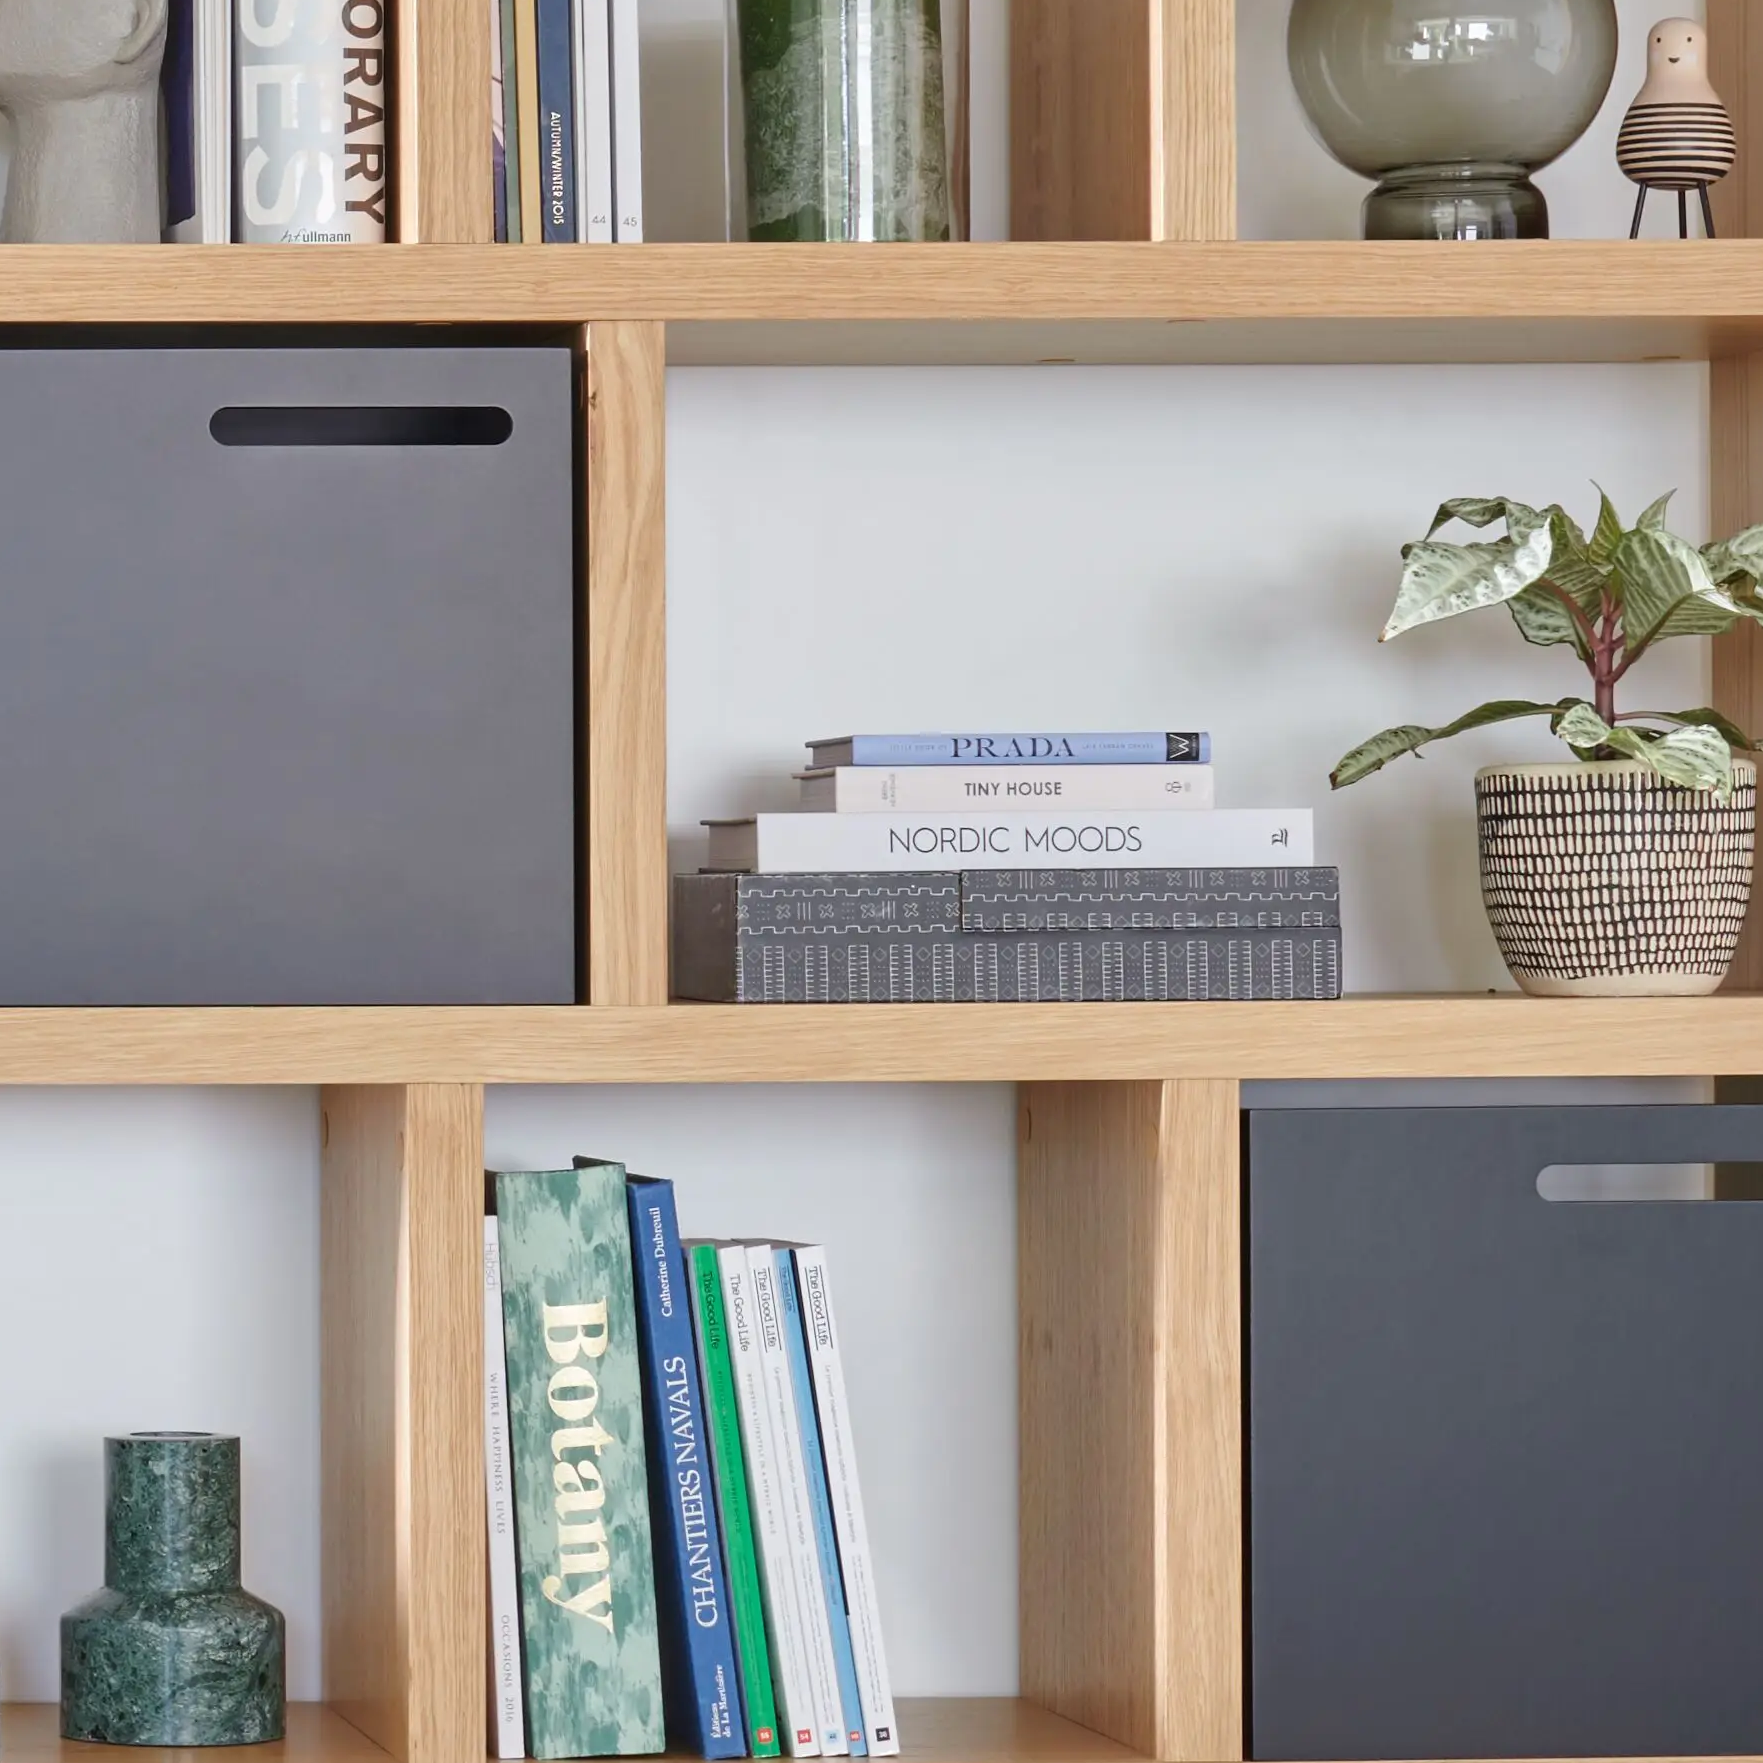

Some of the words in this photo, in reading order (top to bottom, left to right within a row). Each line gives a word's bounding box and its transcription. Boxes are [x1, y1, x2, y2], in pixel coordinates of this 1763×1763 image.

[550, 111, 564, 198] AUTUMN/WINTER
[552, 200, 565, 225] 2015
[950, 736, 1076, 758] PRADA
[964, 782, 1000, 796] TINY
[1006, 781, 1062, 796] HOUSE
[890, 826, 1010, 852] NORDIC
[1025, 825, 1142, 852] MOODS
[649, 1206, 667, 1258] Dubreuil
[654, 1260, 675, 1318] Catherine
[702, 1271, 714, 1293] The
[729, 1273, 741, 1295] The
[757, 1268, 768, 1291] The
[808, 1266, 820, 1289] The
[705, 1294, 719, 1326] Good
[733, 1297, 748, 1329] Good
[761, 1292, 773, 1321] Good
[812, 1290, 825, 1320] Good
[708, 1328, 720, 1350] Life
[737, 1330, 751, 1352] Life
[765, 1325, 777, 1347] Life
[816, 1323, 828, 1345] Life
[489, 1372, 501, 1417] WHERE
[664, 1355, 698, 1465] NAVALS
[491, 1426, 504, 1492] HAPPINESS
[542, 1296, 616, 1633] Botany
[495, 1501, 506, 1534] LIVES
[678, 1468, 719, 1628] CHANTIERS
[500, 1614, 513, 1688] OCCASIONS
[504, 1697, 516, 1723] 2016
